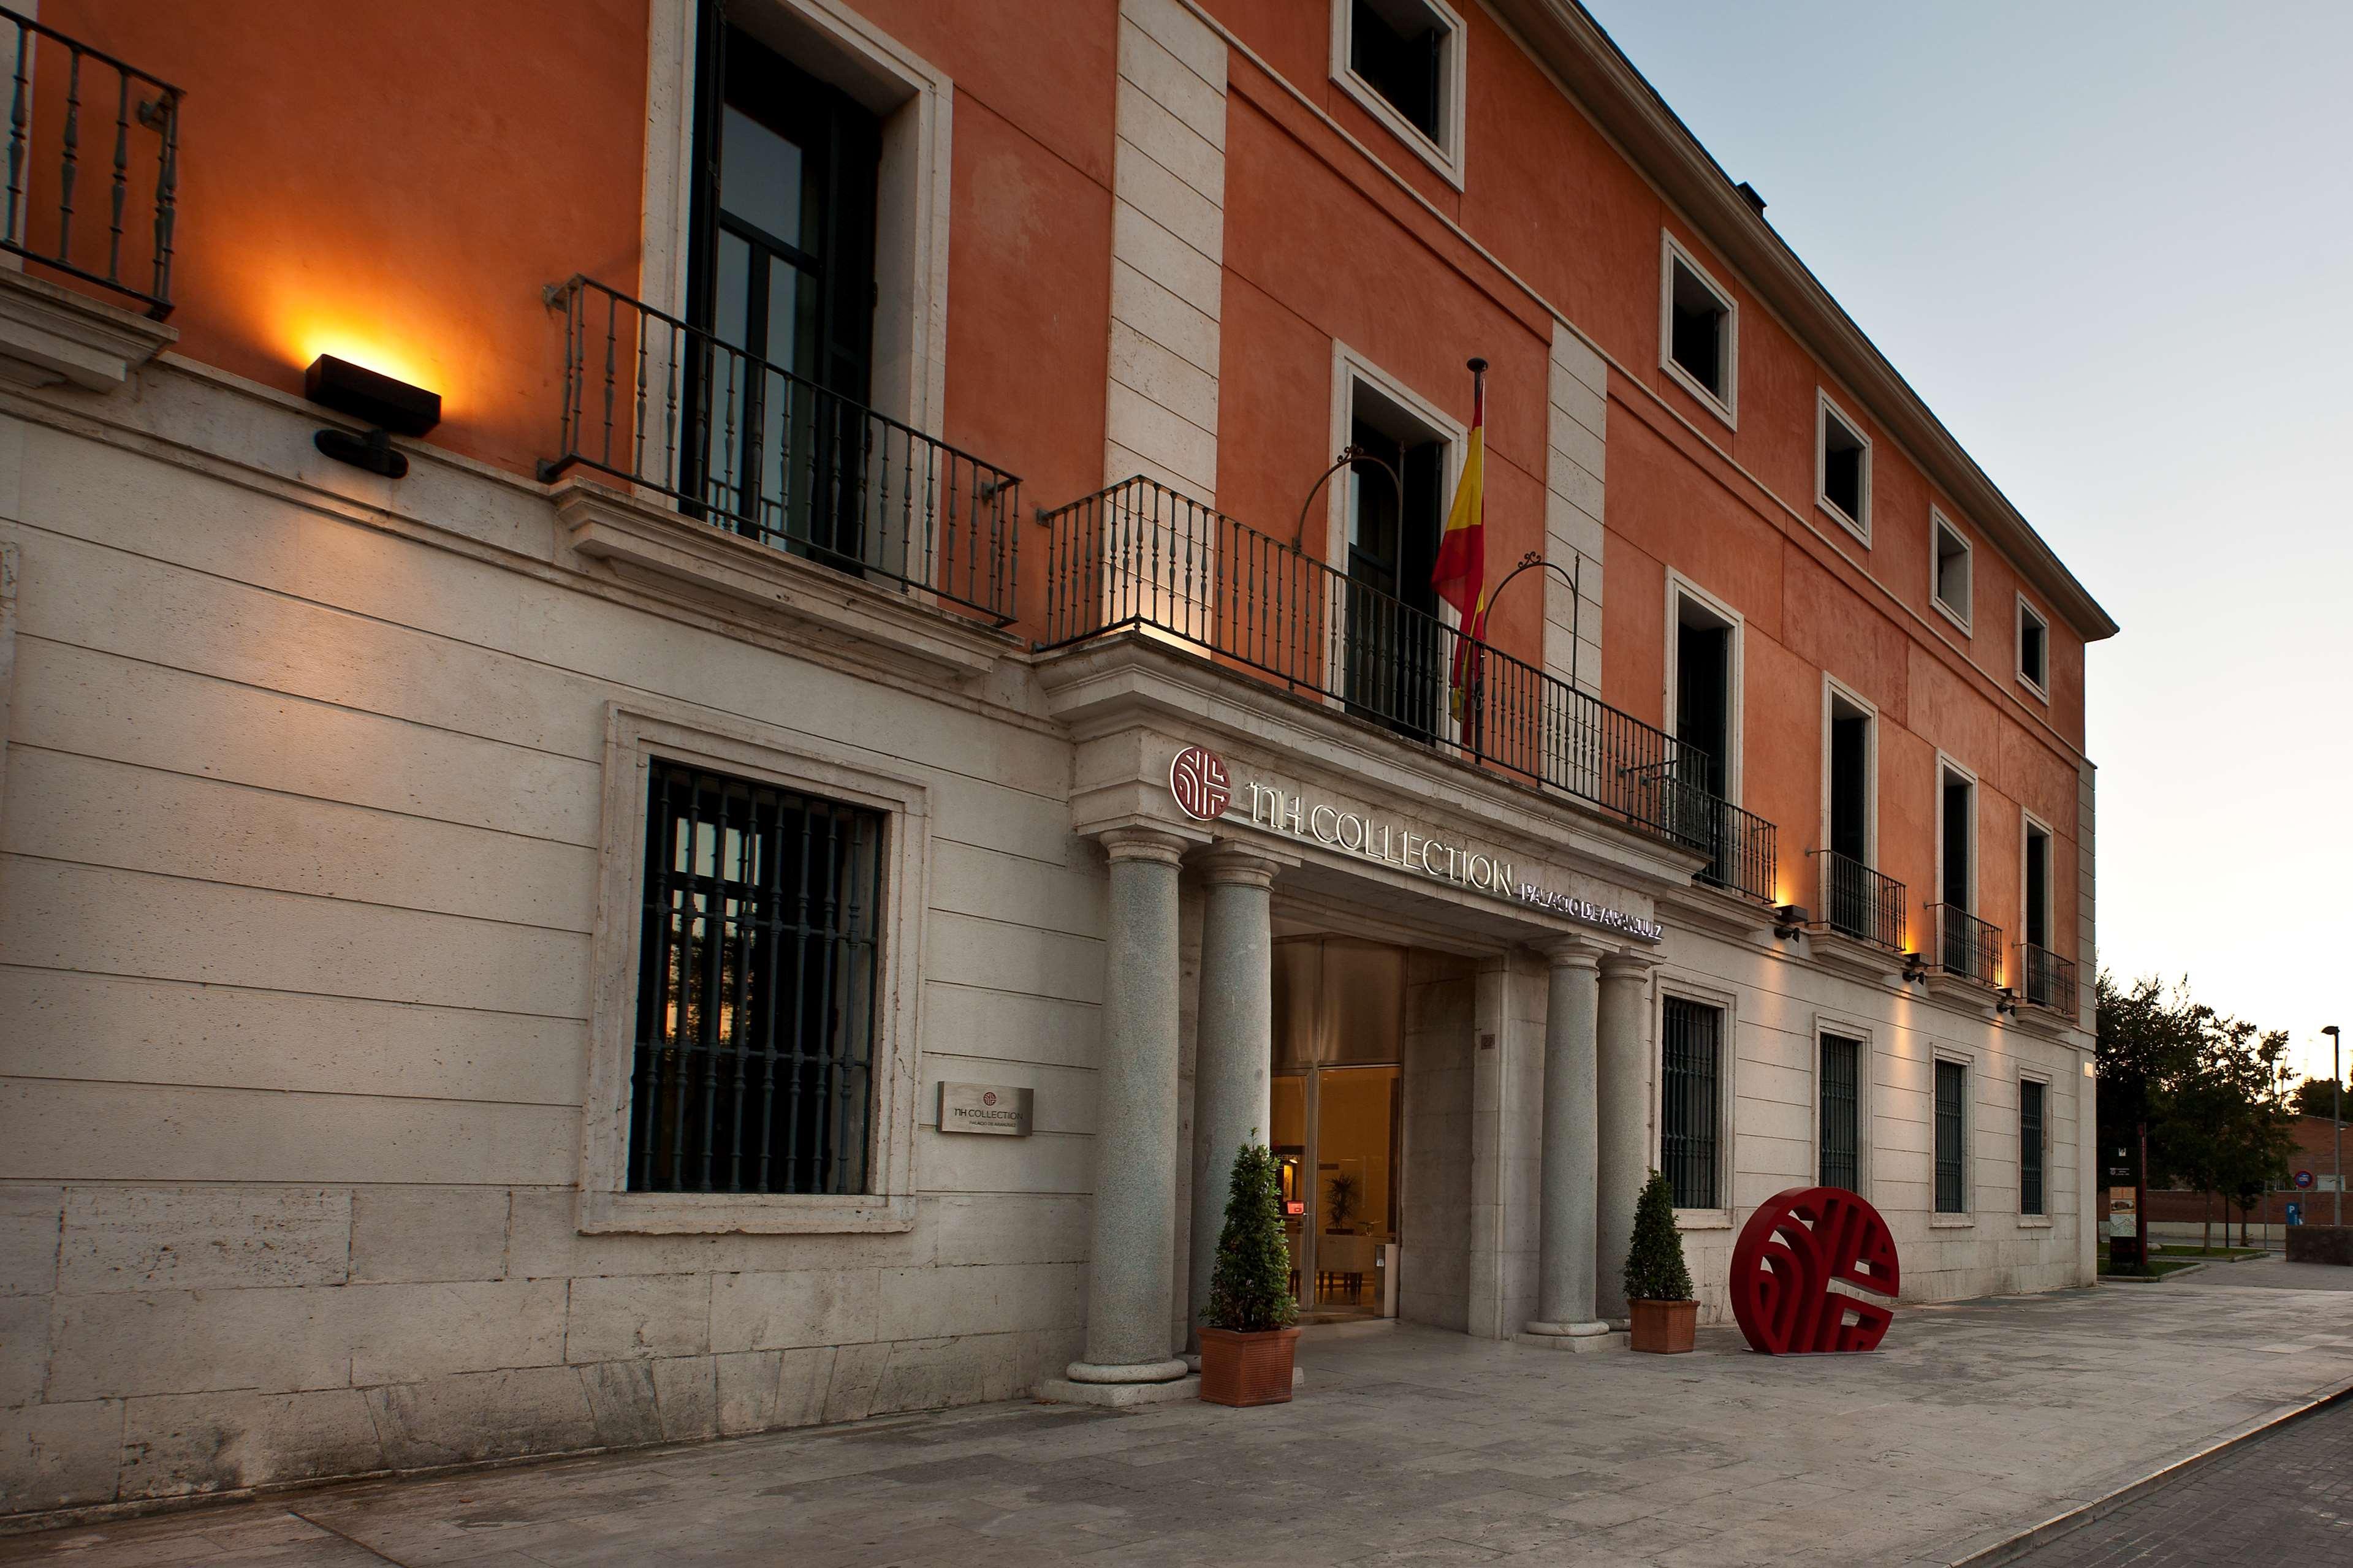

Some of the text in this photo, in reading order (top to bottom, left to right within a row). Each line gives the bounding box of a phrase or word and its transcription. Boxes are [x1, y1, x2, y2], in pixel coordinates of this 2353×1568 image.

[1311, 805, 1514, 896] COLLECTION
[1521, 882, 1580, 915] PALACIO
[1581, 901, 1602, 922] DE
[968, 1109, 1023, 1119] COLLECTION
[2288, 1205, 2295, 1213] P
